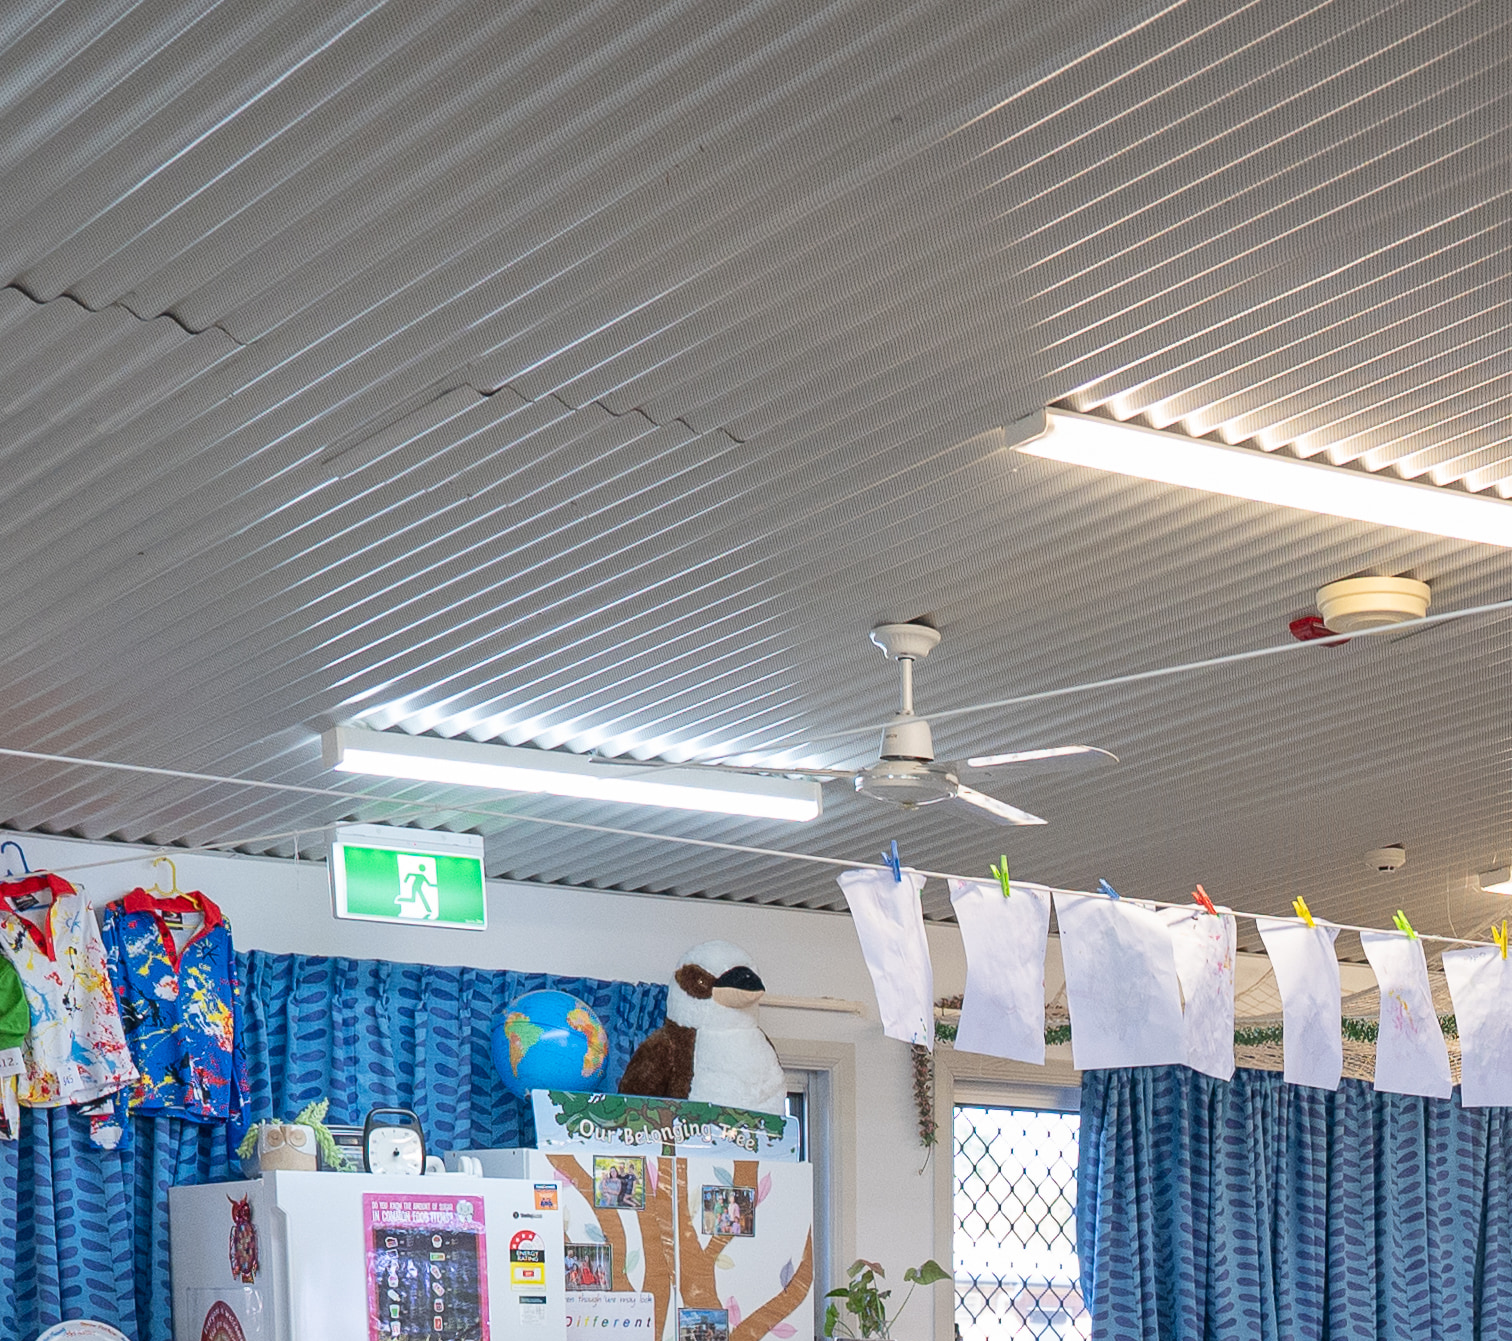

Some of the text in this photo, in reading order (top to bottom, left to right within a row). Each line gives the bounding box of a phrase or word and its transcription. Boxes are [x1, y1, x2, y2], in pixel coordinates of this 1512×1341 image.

[579, 1118, 756, 1151] Our Belonging Tree
[566, 1315, 651, 1328] Different
